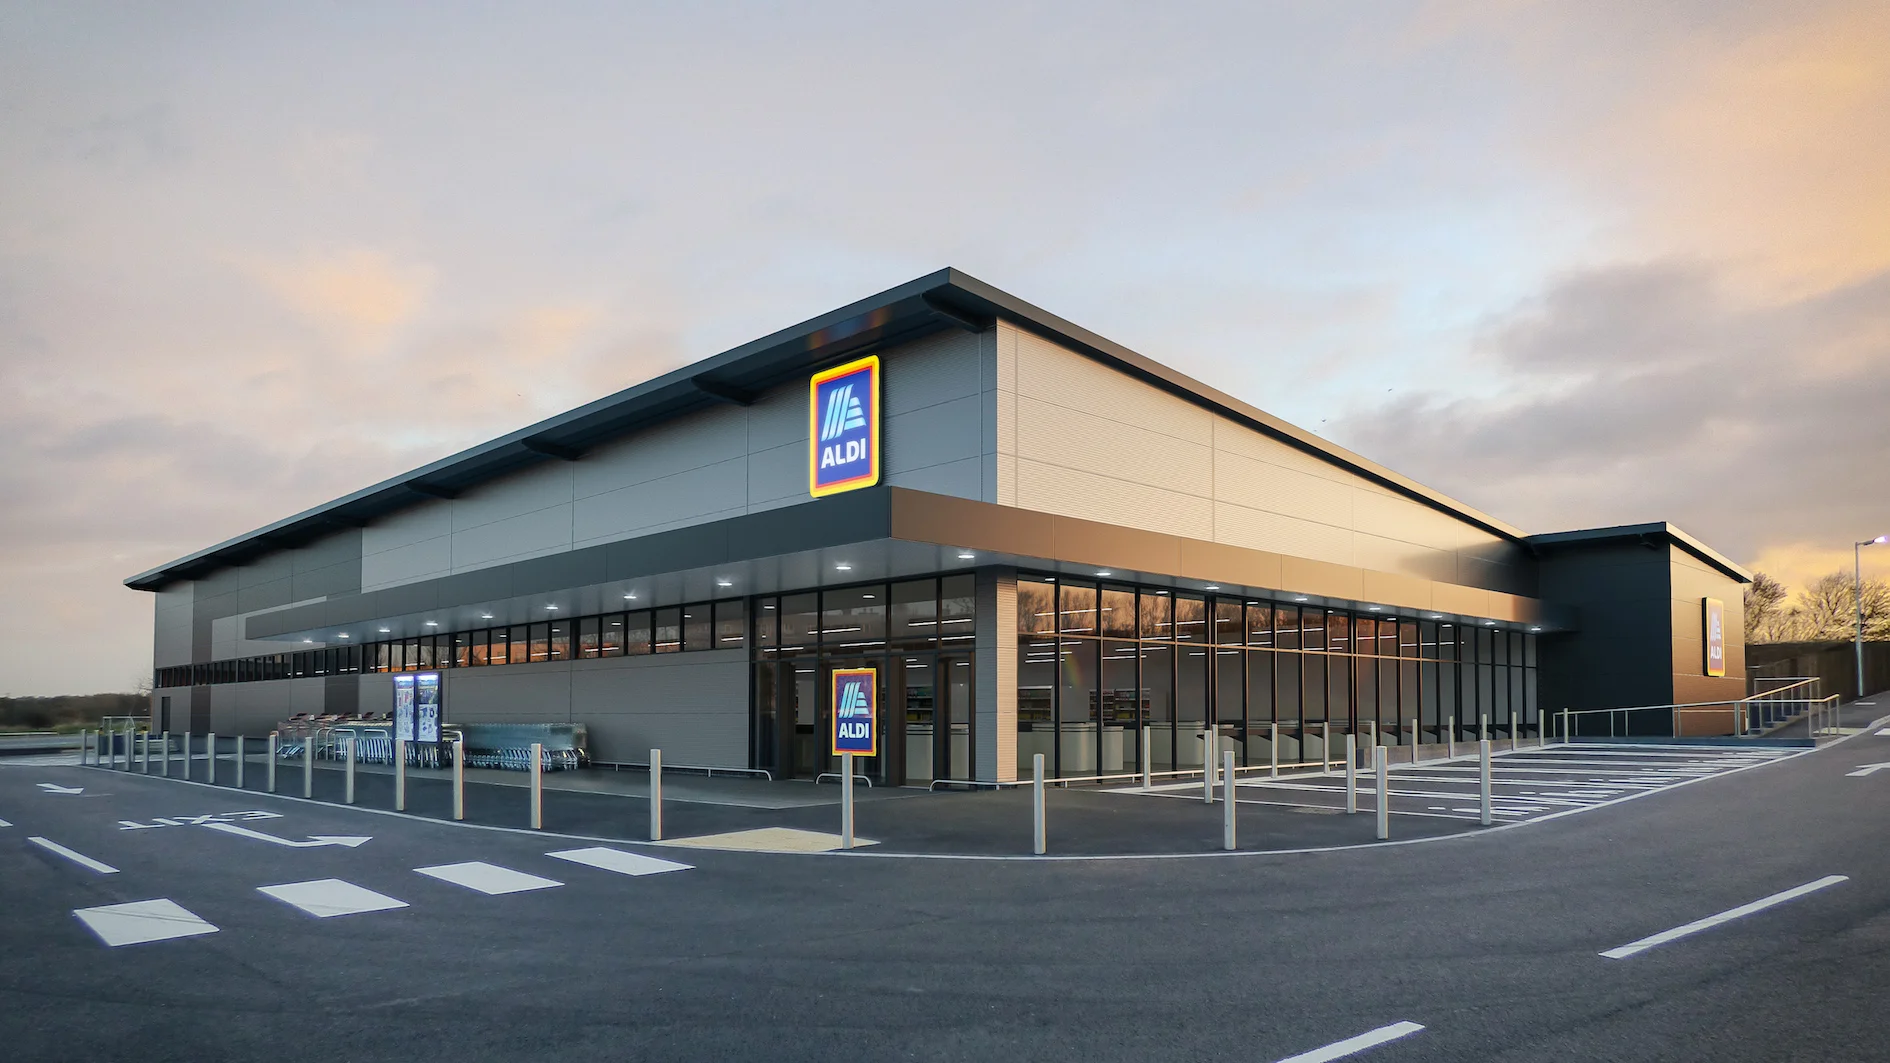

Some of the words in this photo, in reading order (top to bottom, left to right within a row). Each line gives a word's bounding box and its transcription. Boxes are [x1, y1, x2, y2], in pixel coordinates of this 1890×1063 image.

[821, 438, 866, 469] ALDI
[1710, 645, 1722, 660] ALDI
[838, 722, 870, 739] ALDI
[118, 810, 284, 830] EXIT
